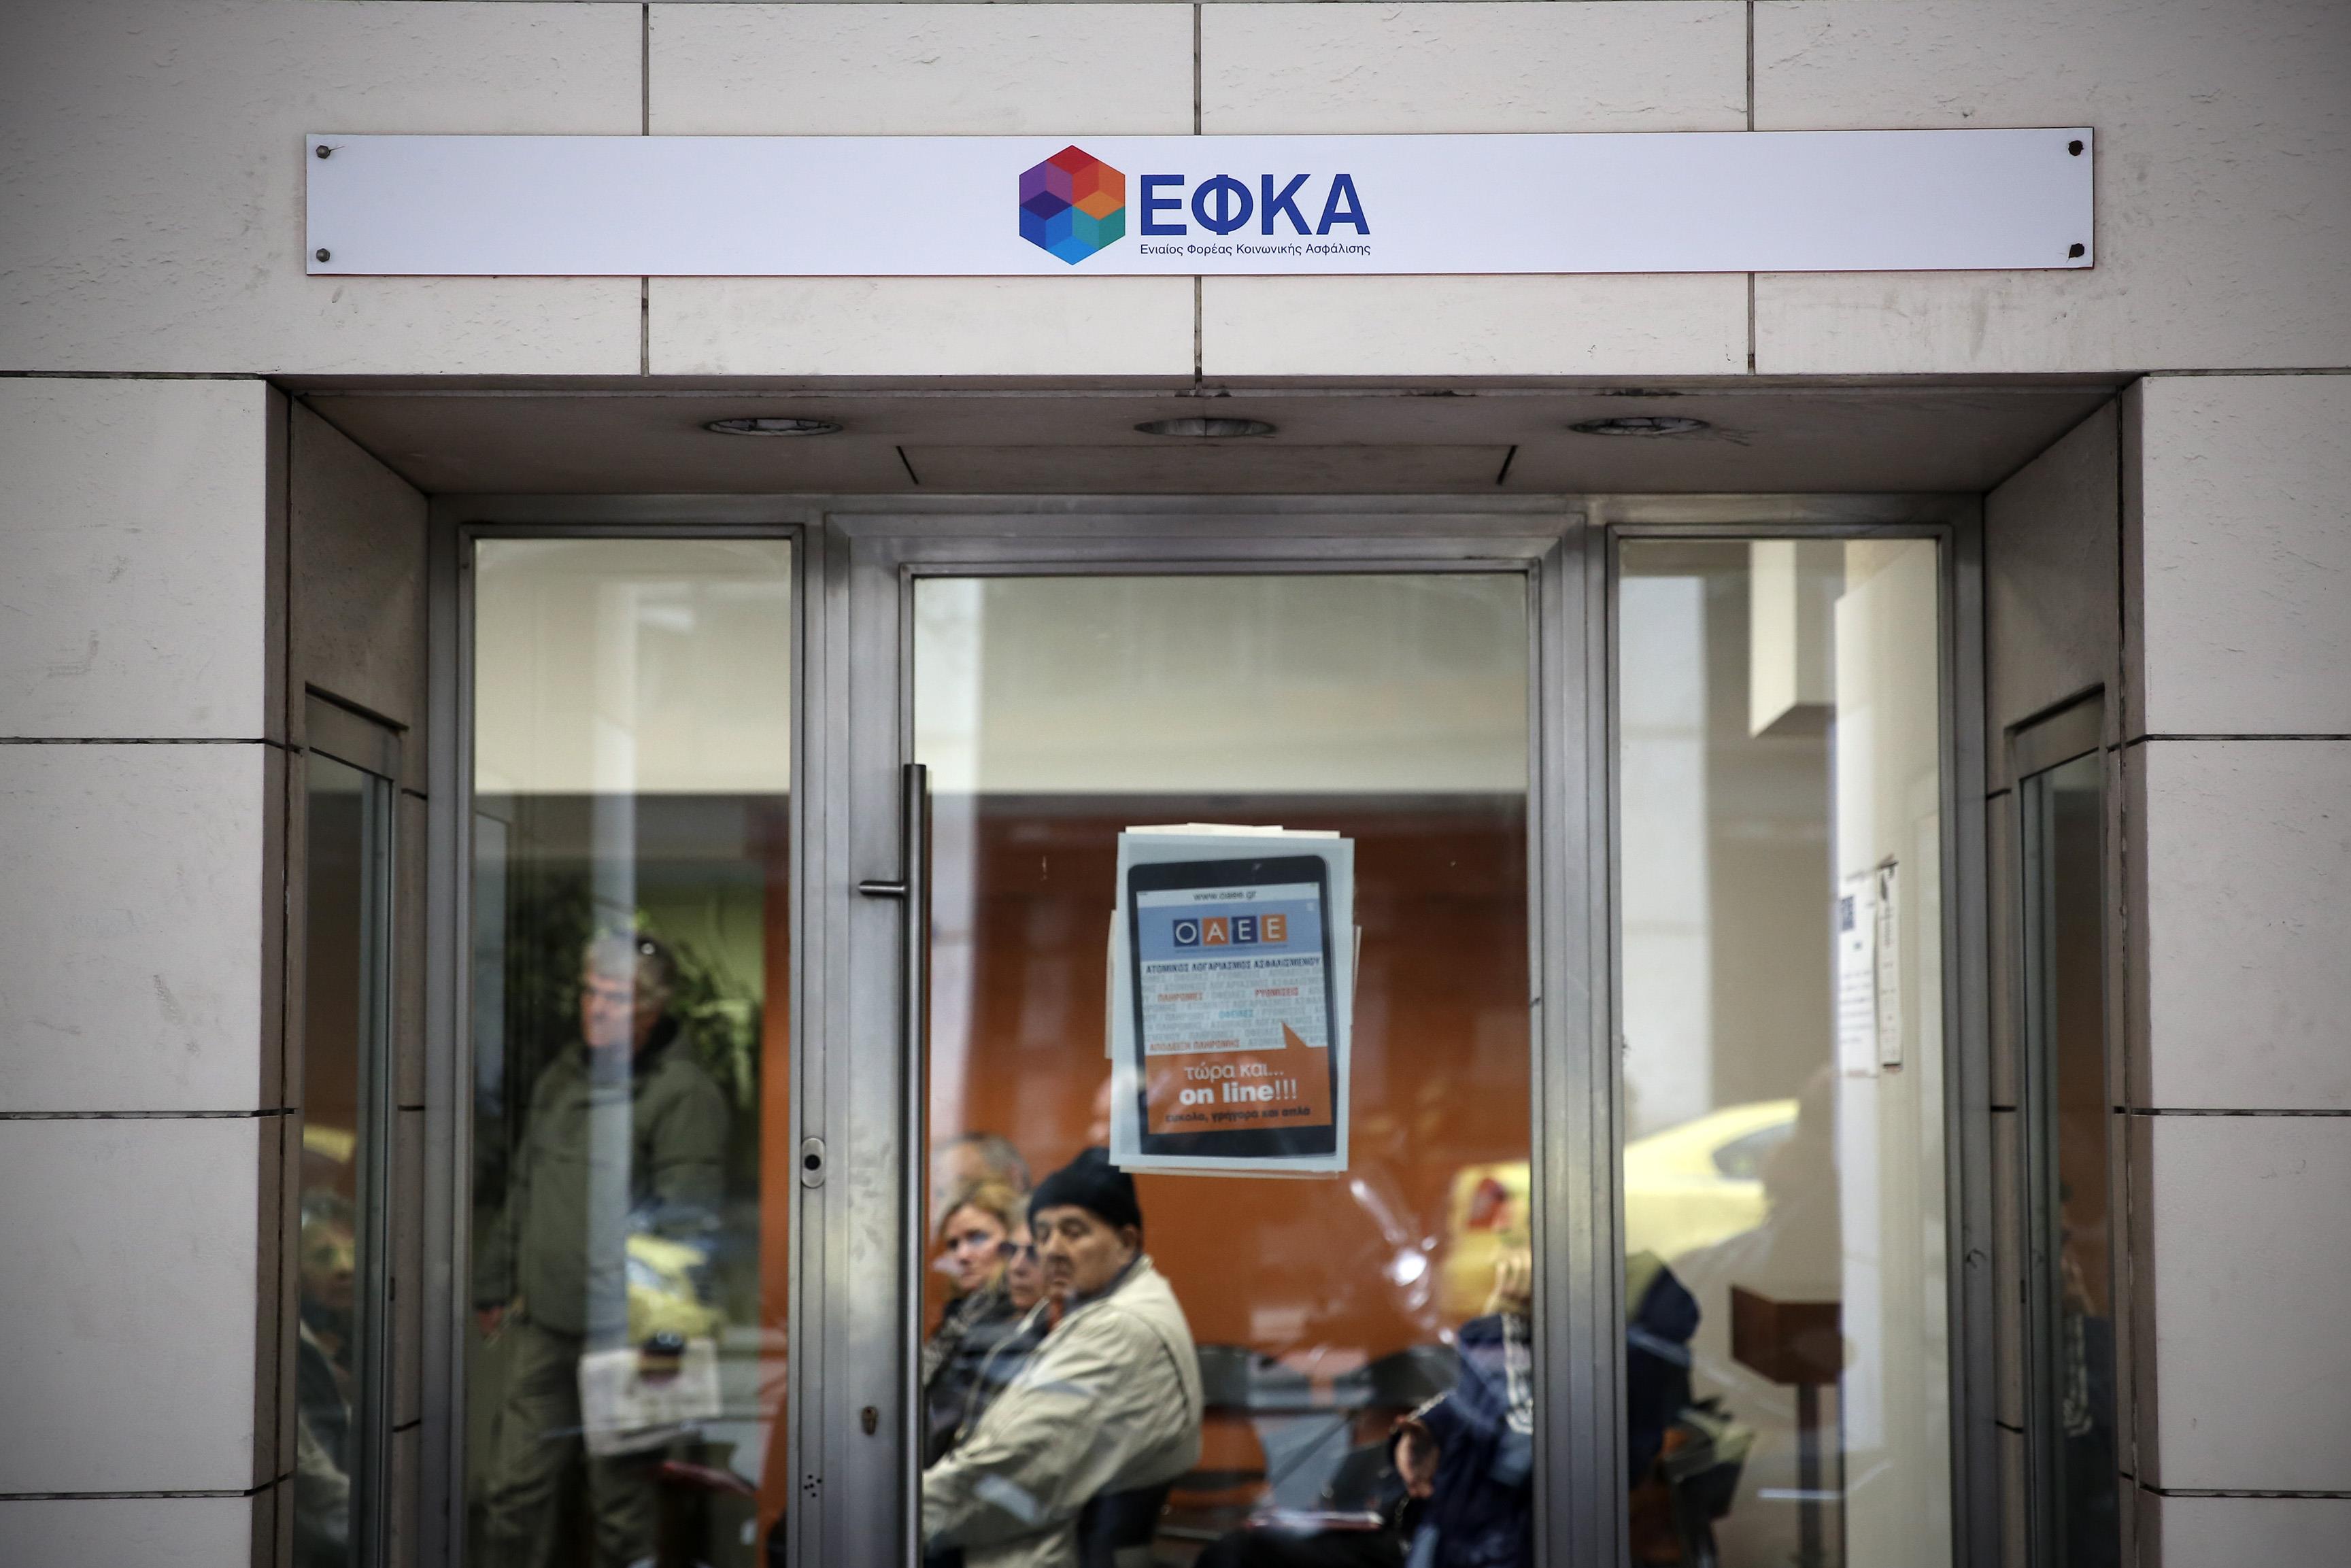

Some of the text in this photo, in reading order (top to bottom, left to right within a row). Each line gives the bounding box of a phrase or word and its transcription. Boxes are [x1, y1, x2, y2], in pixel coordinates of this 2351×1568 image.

[1140, 173, 1371, 235] ΕΦΚΑ
[1140, 243, 1371, 256] Ενιαίος Φορέας Κοινωνικής Ασφάλισης
[1174, 917, 1282, 944] ΟΑΕΕ
[1184, 1062, 1284, 1083] τώρα και...
[1179, 1078, 1298, 1106] on line!!!
[1262, 1108, 1279, 1118] και
